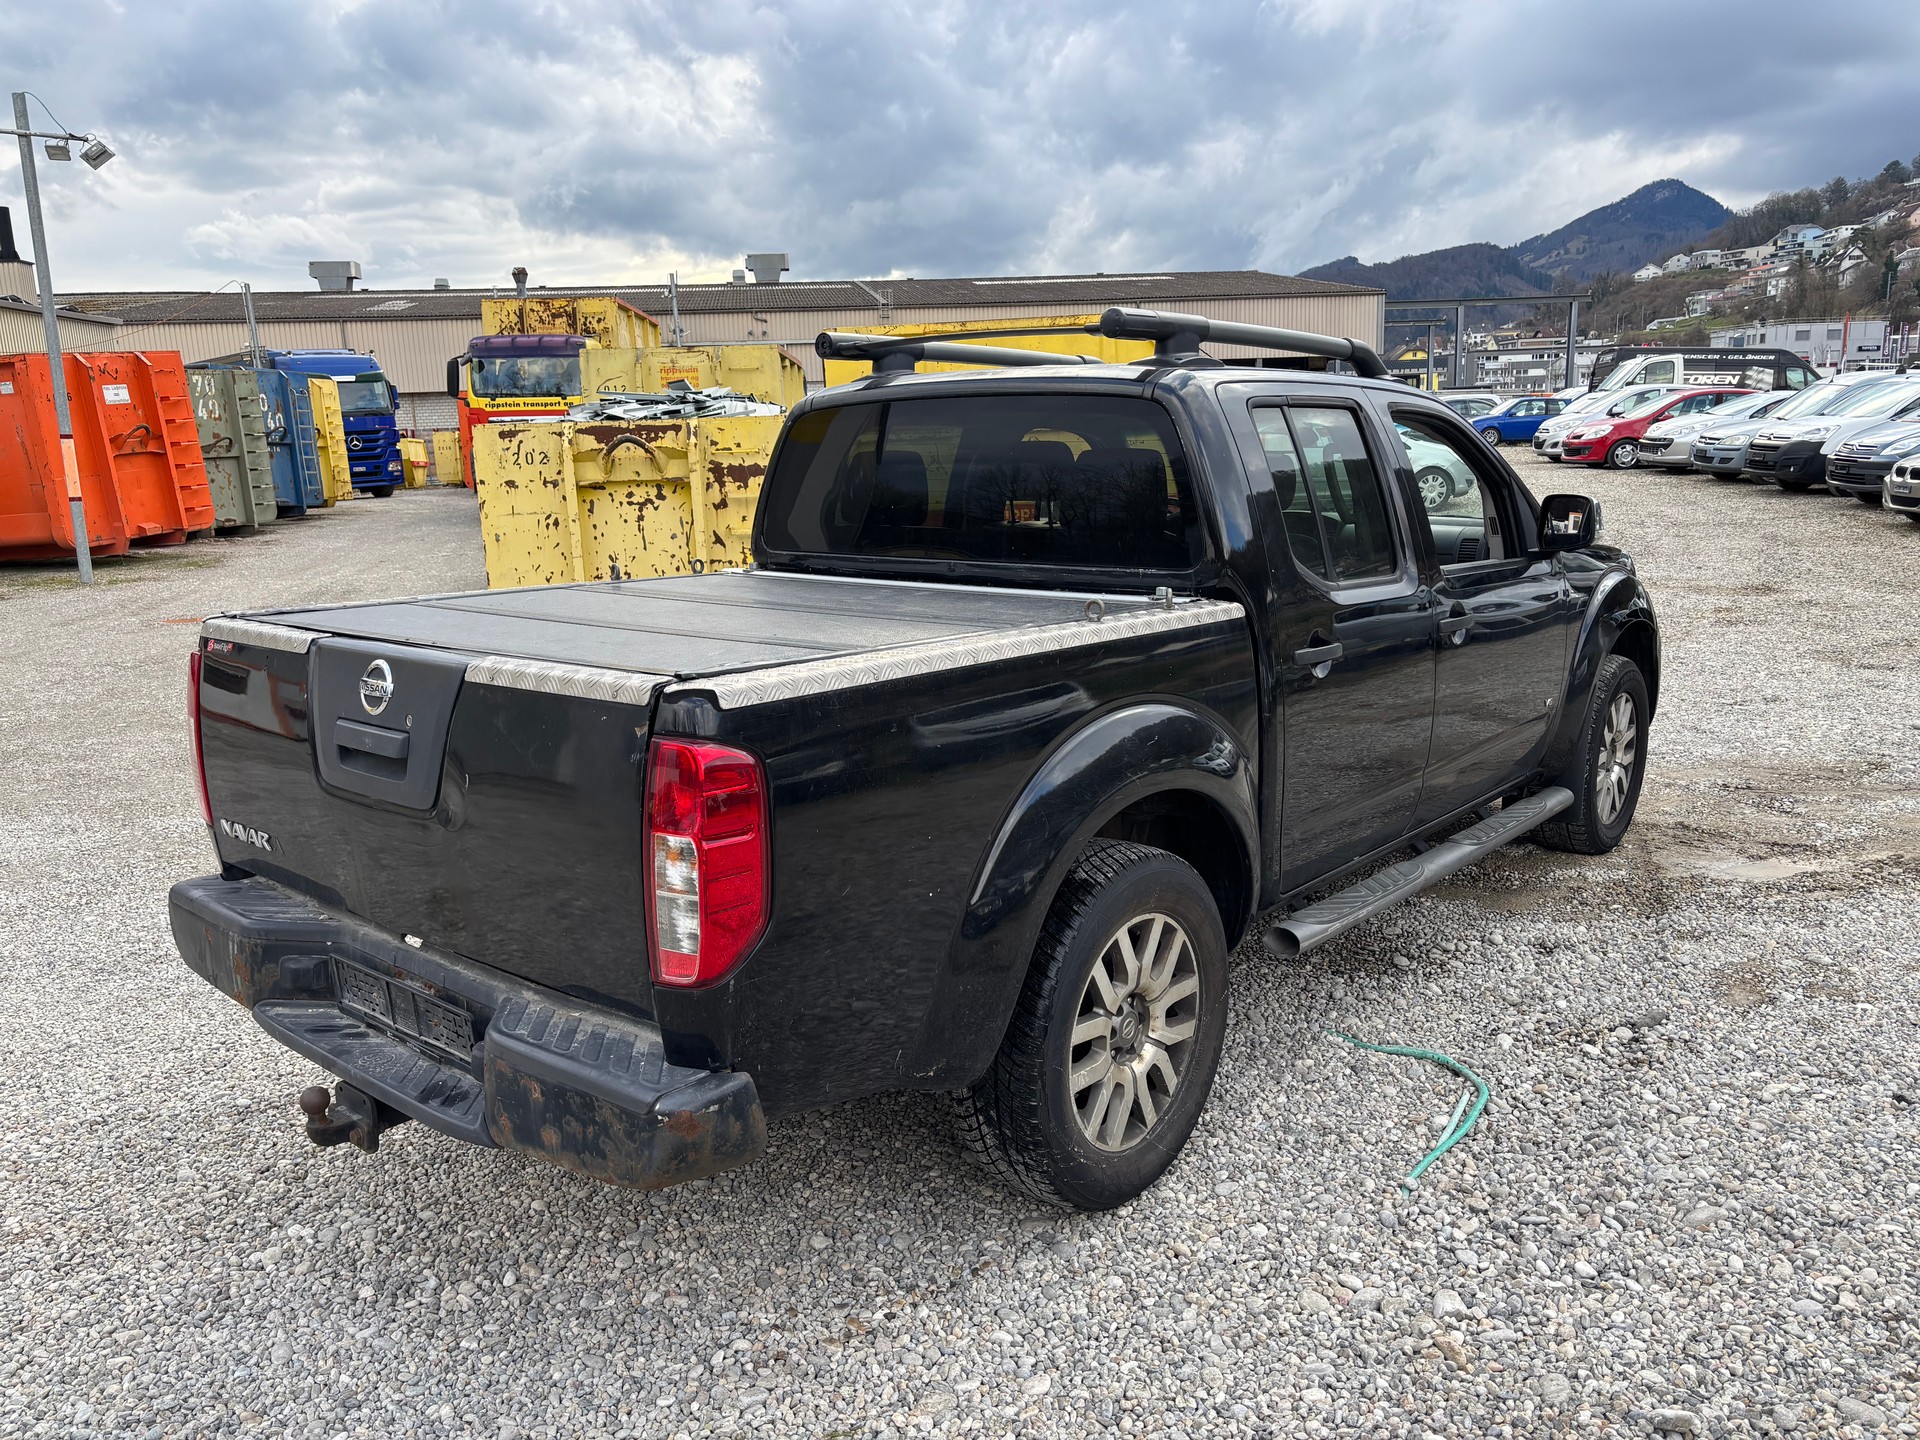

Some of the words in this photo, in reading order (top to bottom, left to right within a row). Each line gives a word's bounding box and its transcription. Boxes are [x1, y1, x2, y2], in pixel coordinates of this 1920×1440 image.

[660, 366, 699, 376] rippstein
[1683, 374, 1740, 385] OREN
[198, 399, 219, 420] 40
[485, 401, 521, 409] rippstein
[512, 450, 551, 466] 202
[361, 681, 389, 696] NISSAN
